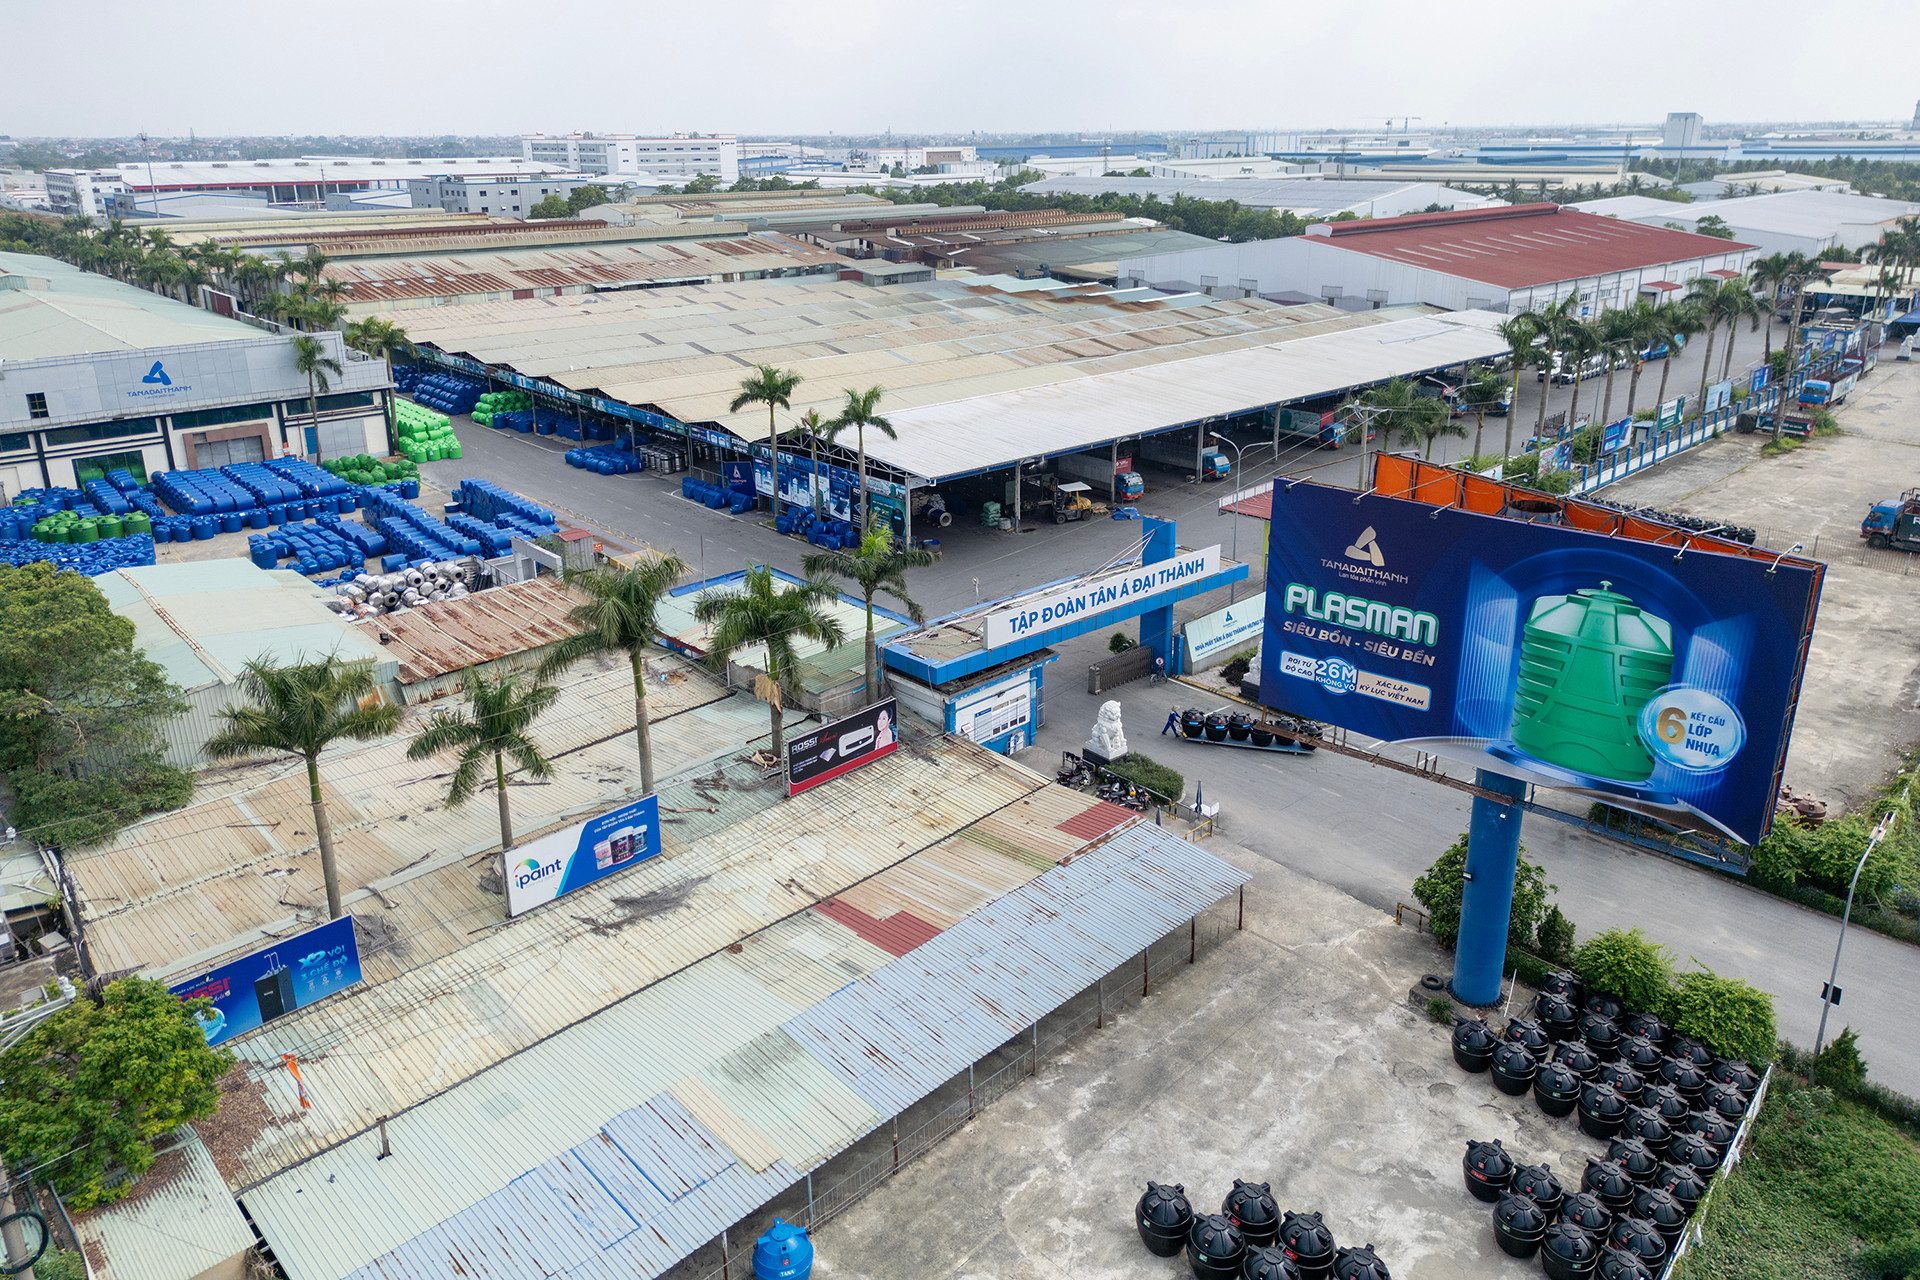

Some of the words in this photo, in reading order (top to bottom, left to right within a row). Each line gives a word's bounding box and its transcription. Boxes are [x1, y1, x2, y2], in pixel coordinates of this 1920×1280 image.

[127, 385, 192, 398] TANADAITHANH
[1320, 558, 1409, 584] TANADAITHANH
[1338, 571, 1349, 579] Lan
[1009, 610, 1039, 634] TẬP
[1041, 596, 1086, 624] ĐOÀN
[1089, 586, 1117, 610] TÂN
[1119, 578, 1129, 598] Á
[1132, 575, 1156, 594] ĐẠI
[1158, 557, 1205, 584] THÀNH
[1285, 583, 1438, 646] PLASMAN
[1283, 621, 1317, 637] SIÊU
[1318, 629, 1352, 647] BỒN
[1364, 640, 1399, 658] SIÊU
[1402, 650, 1435, 666] BỀN
[1288, 657, 1301, 666] RƠI
[1285, 665, 1296, 673] ĐỘ
[1297, 667, 1313, 677] CAO
[1316, 660, 1358, 684] 26M
[1315, 676, 1343, 688] KHÔNG
[1376, 680, 1391, 689] XÁC
[1393, 683, 1408, 692] LẬP
[1370, 687, 1385, 696] LỤC
[1388, 690, 1404, 701] VIỆT
[1405, 697, 1424, 705] NAM
[1656, 707, 1687, 744] 6
[1691, 712, 1706, 722] KẾT
[1708, 715, 1726, 727] CẤU
[1688, 723, 1713, 738] LỚP
[791, 736, 818, 753] ROSSI
[1685, 738, 1720, 756] NHỰA
[514, 858, 562, 889] ipaint
